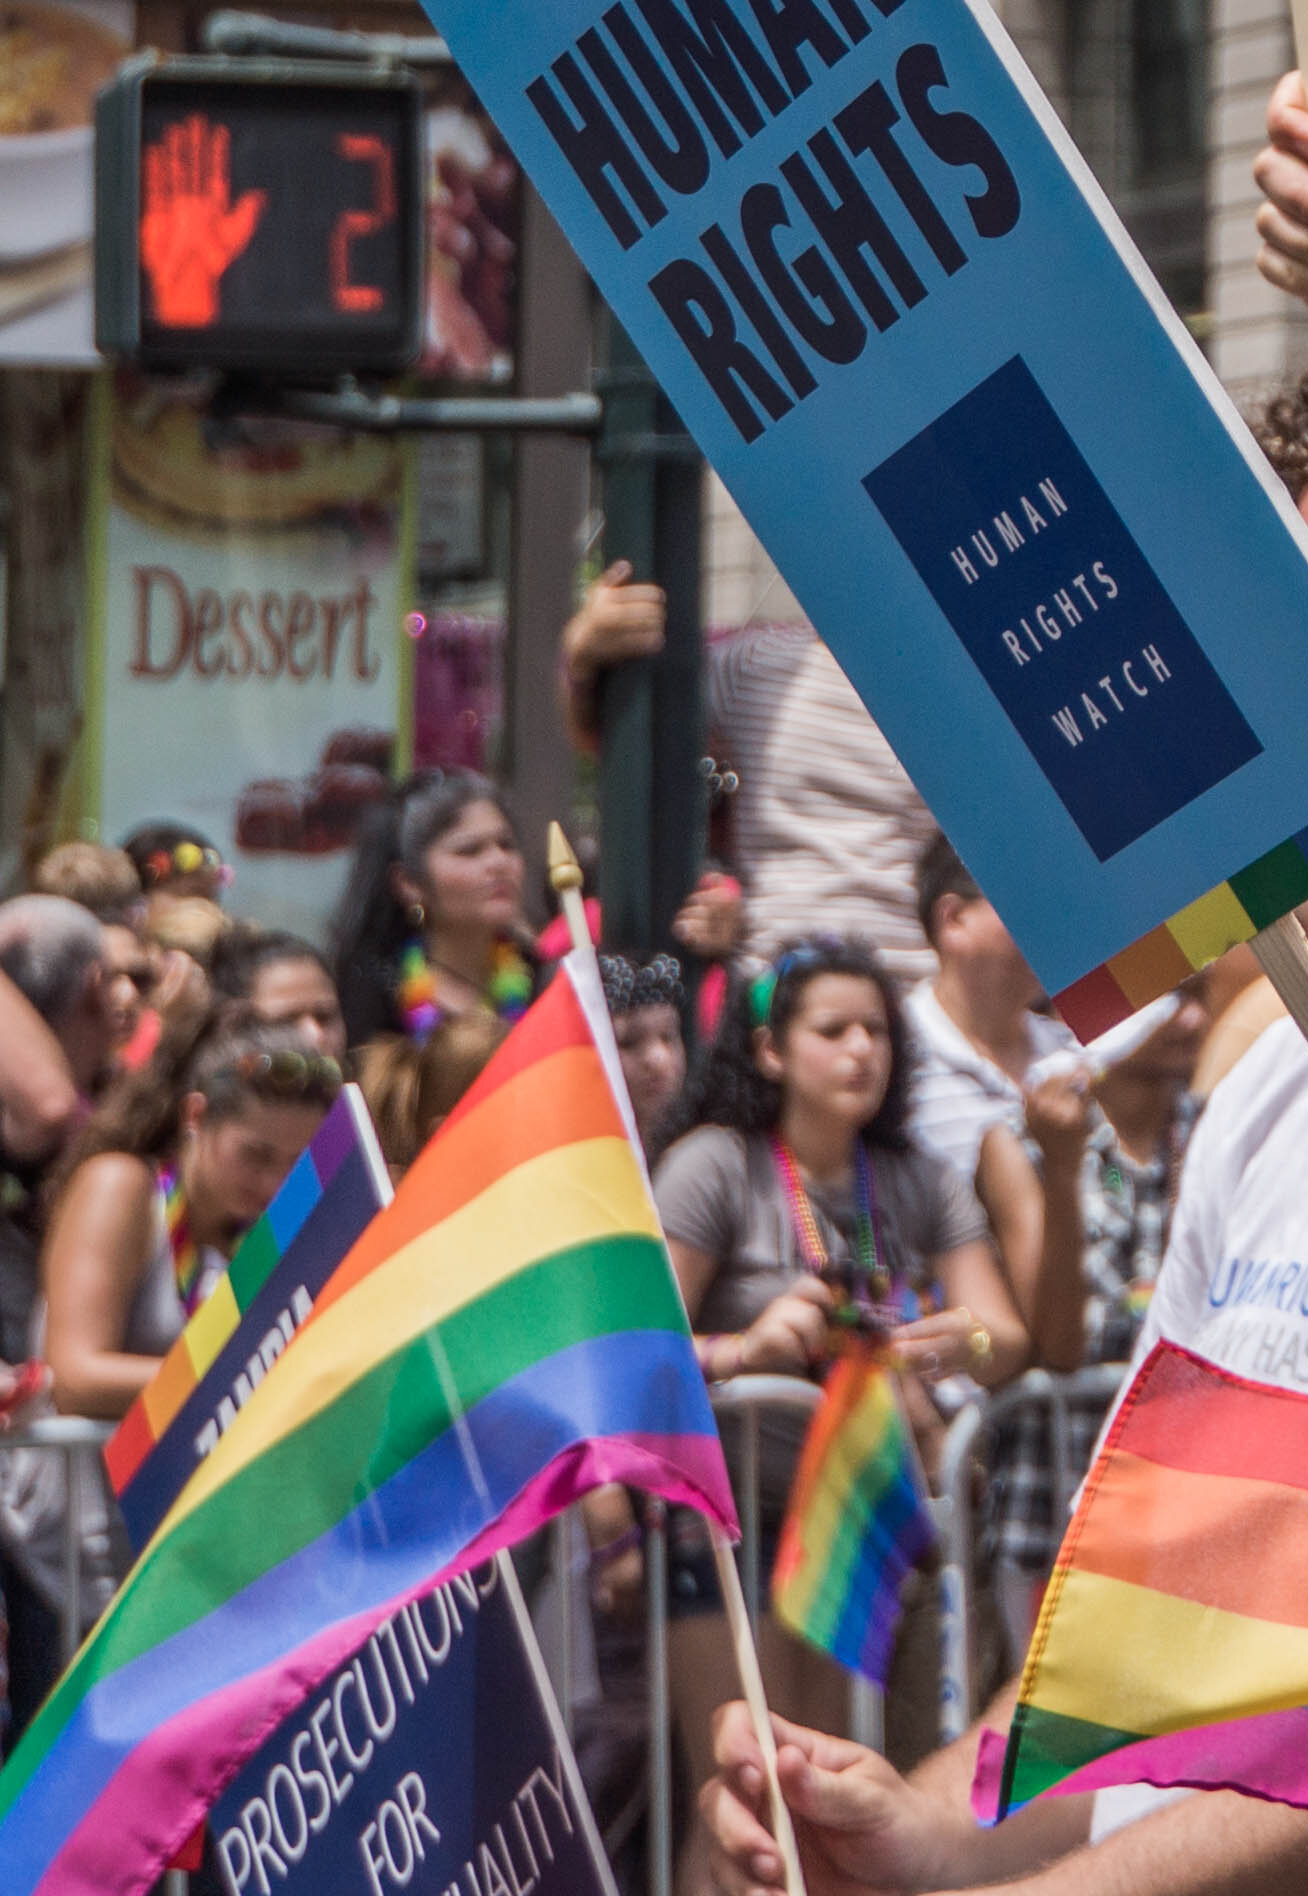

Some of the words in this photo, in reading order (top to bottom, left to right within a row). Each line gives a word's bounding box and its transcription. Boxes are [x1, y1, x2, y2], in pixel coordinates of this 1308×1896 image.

[329, 132, 398, 311] 2
[647, 43, 1022, 446] RIGHTS
[950, 477, 1068, 585] HUMAN
[128, 563, 382, 681] Dessert
[1002, 560, 1119, 666] RIGHTS
[1051, 643, 1172, 748] WATCH
[359, 1770, 441, 1896] FOR
